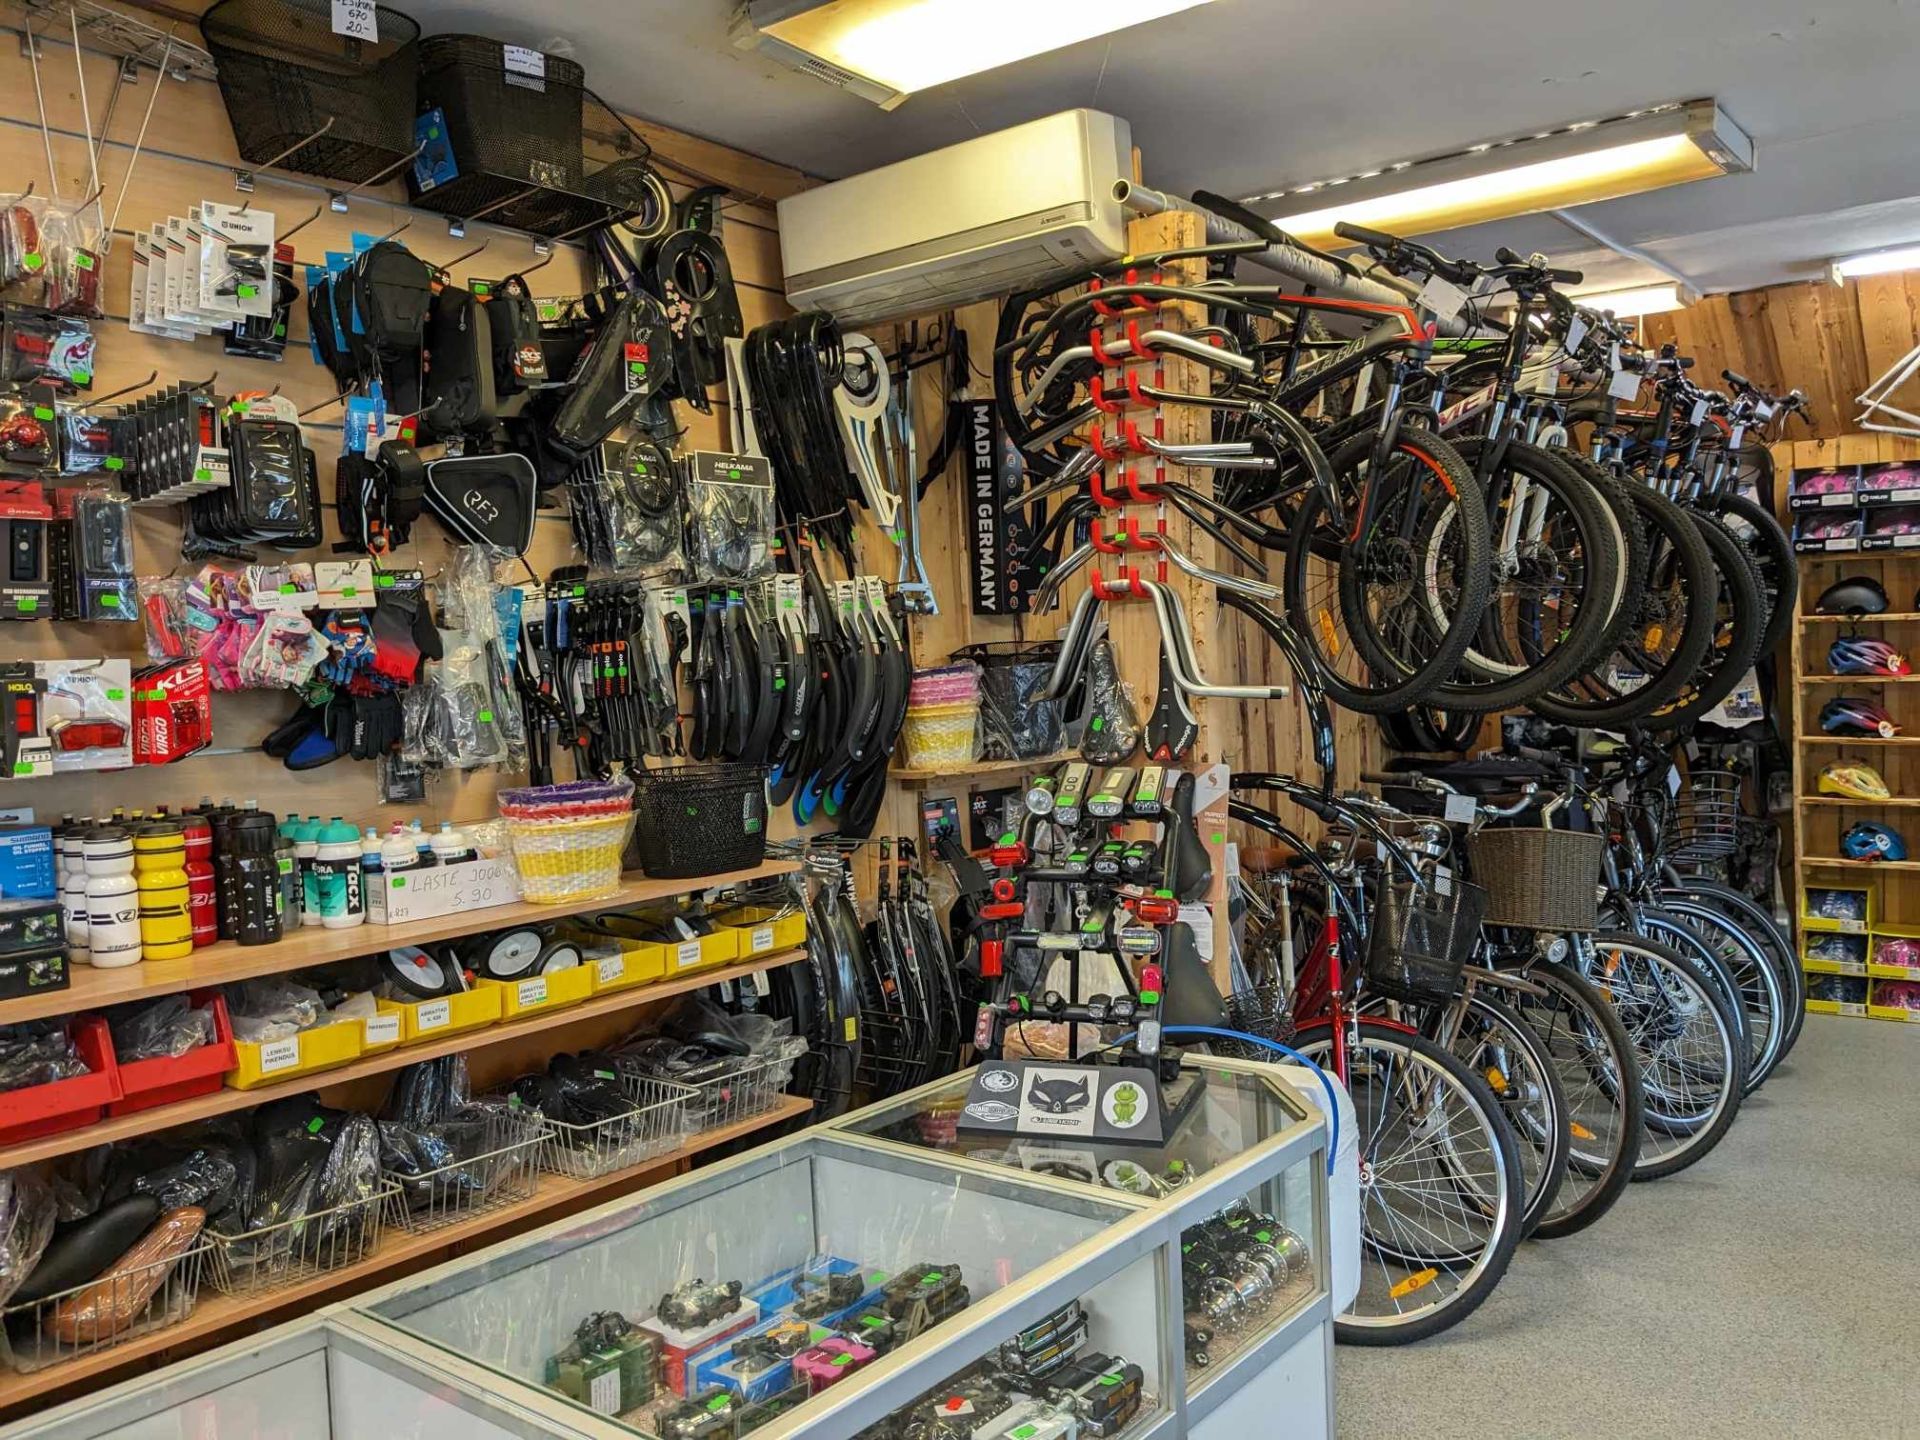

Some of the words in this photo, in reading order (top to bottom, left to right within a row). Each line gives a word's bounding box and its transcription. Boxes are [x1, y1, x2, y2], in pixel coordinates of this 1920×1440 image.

[348, 9, 368, 21] 670
[229, 221, 253, 232] UNION
[973, 405, 991, 469] MADE
[714, 461, 754, 472] HELKAMA
[976, 475, 992, 498] IN
[977, 503, 996, 611] GERMANY
[156, 664, 204, 691] KLS
[155, 716, 169, 755] VIRGO
[411, 870, 458, 893] LASTE
[264, 1052, 296, 1065] PIKENDUS
[266, 1046, 291, 1057] LENKSU
